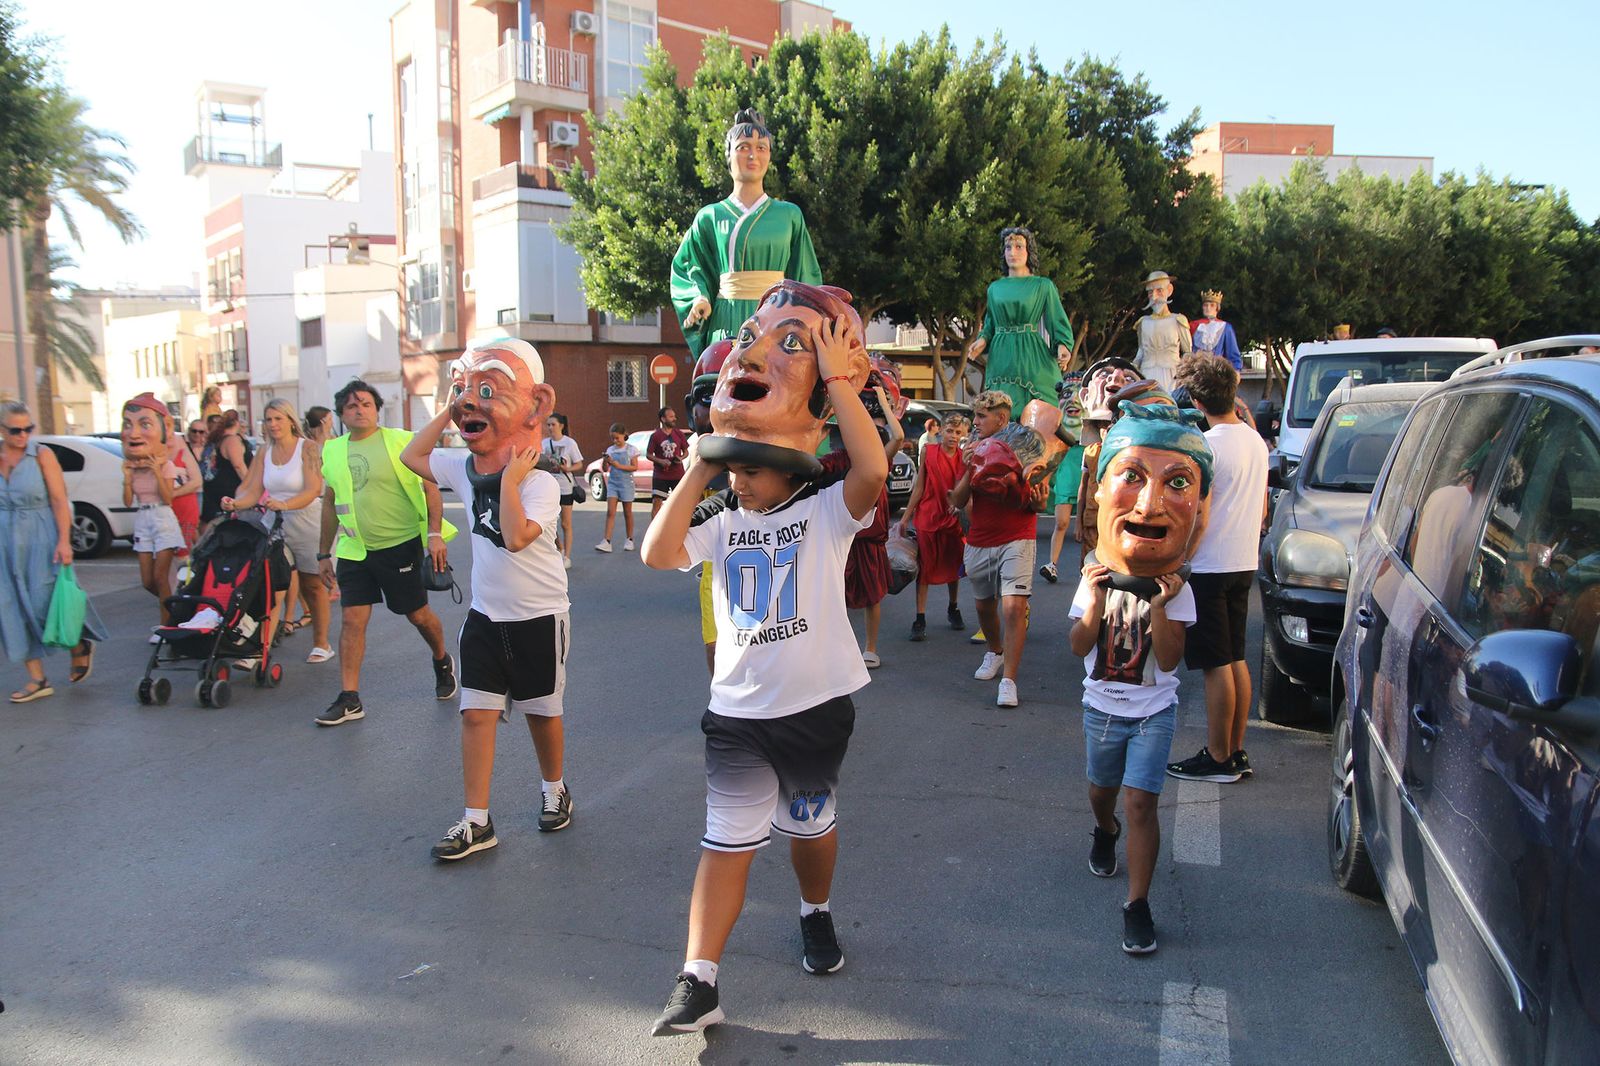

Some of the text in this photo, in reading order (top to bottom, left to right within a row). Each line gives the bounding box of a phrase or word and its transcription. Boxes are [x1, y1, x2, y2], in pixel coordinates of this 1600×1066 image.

[728, 519, 808, 546] EAGLE ROCK
[750, 618, 808, 646] ANGELES
[790, 792, 830, 822] 07
